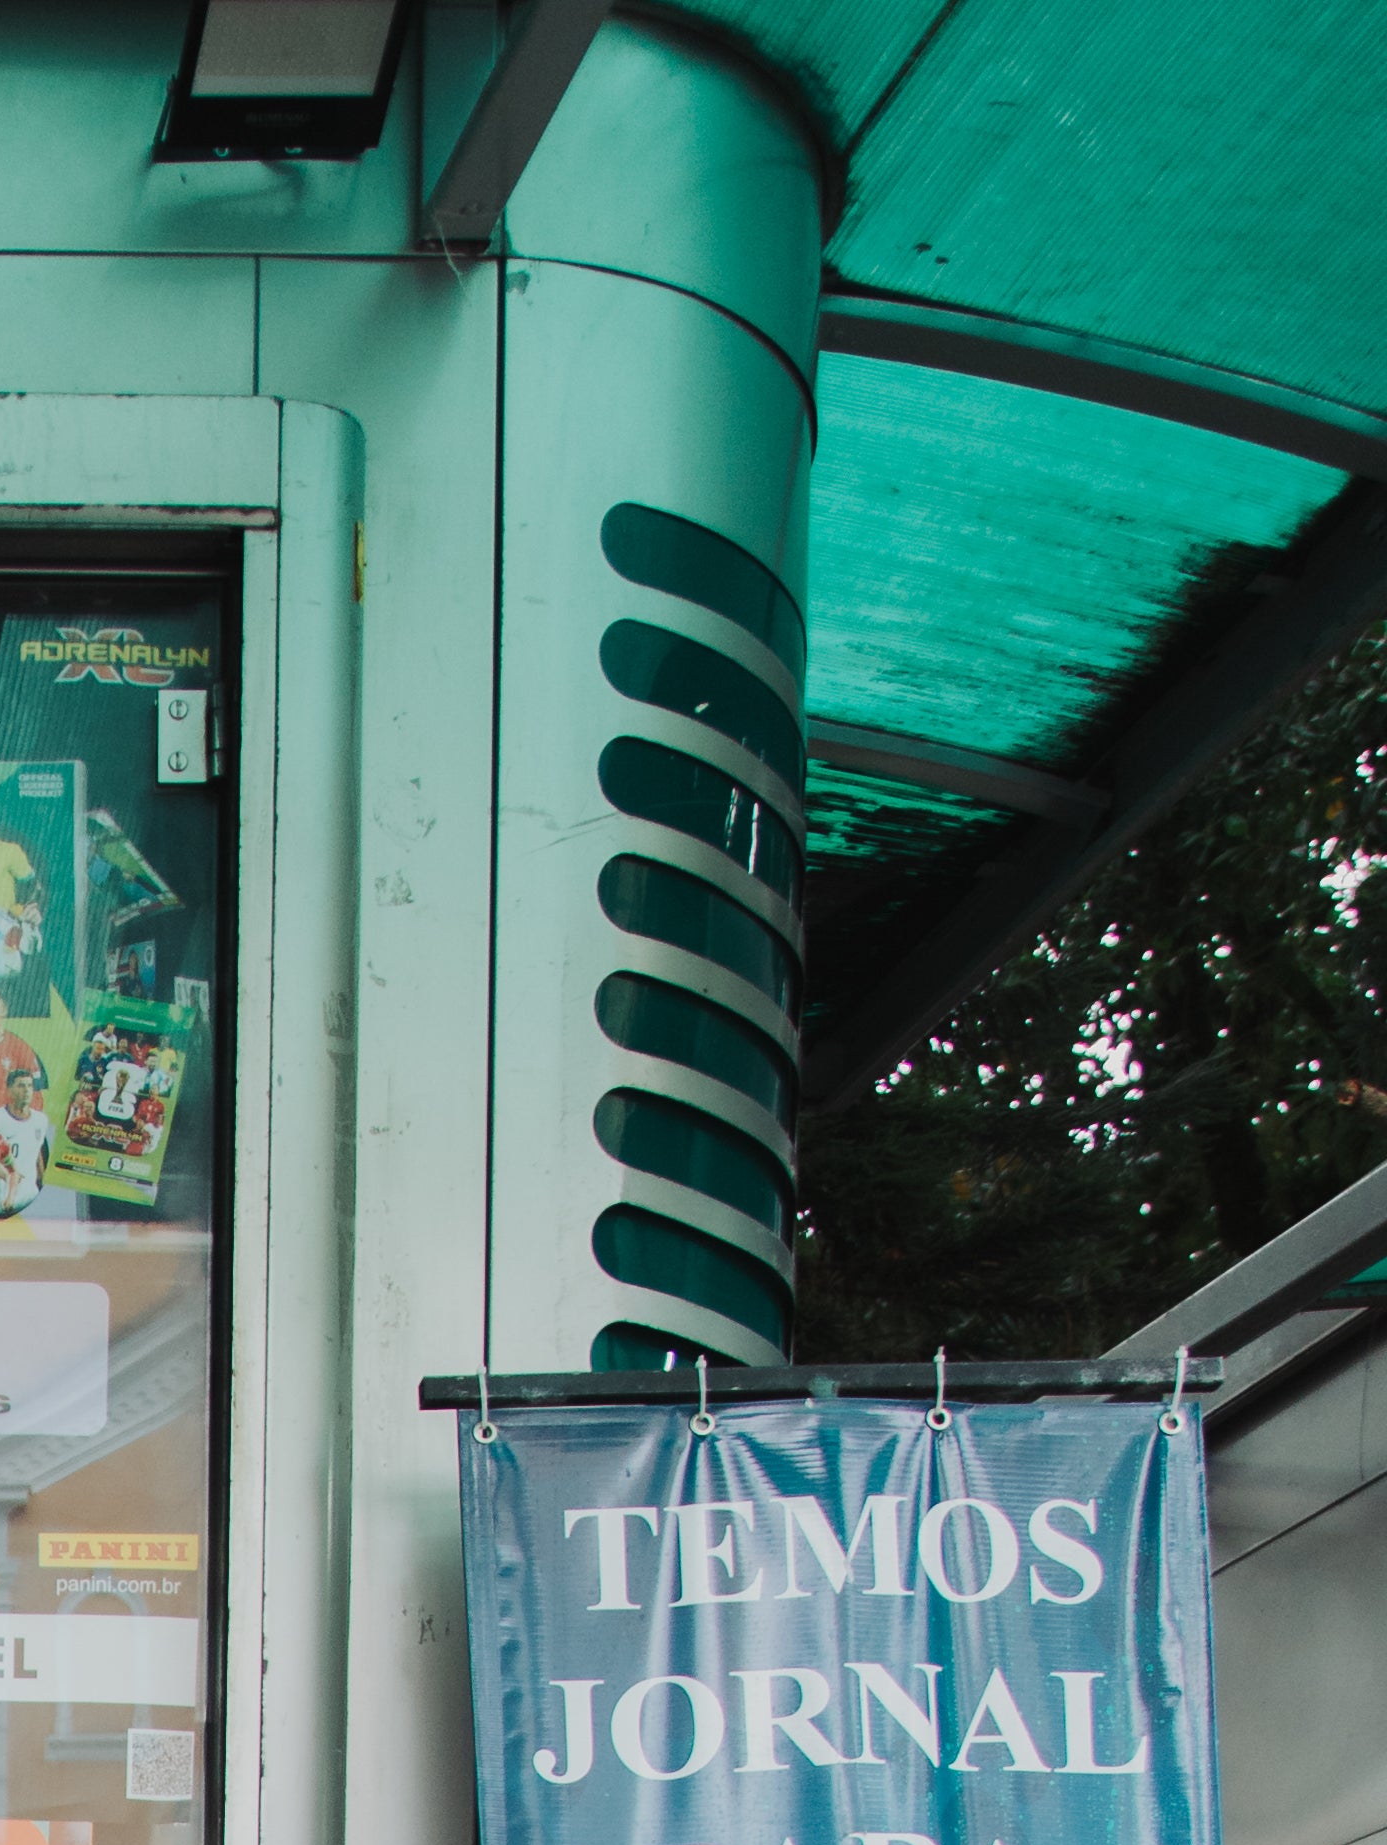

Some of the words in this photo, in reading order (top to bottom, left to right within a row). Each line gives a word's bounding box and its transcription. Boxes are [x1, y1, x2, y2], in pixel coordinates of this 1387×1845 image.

[47, 1540, 191, 1563] PANINI
[55, 1574, 182, 1596] panini.com.br
[563, 1490, 1105, 1614] TEMOS
[530, 1660, 1148, 1787] JORNAL
